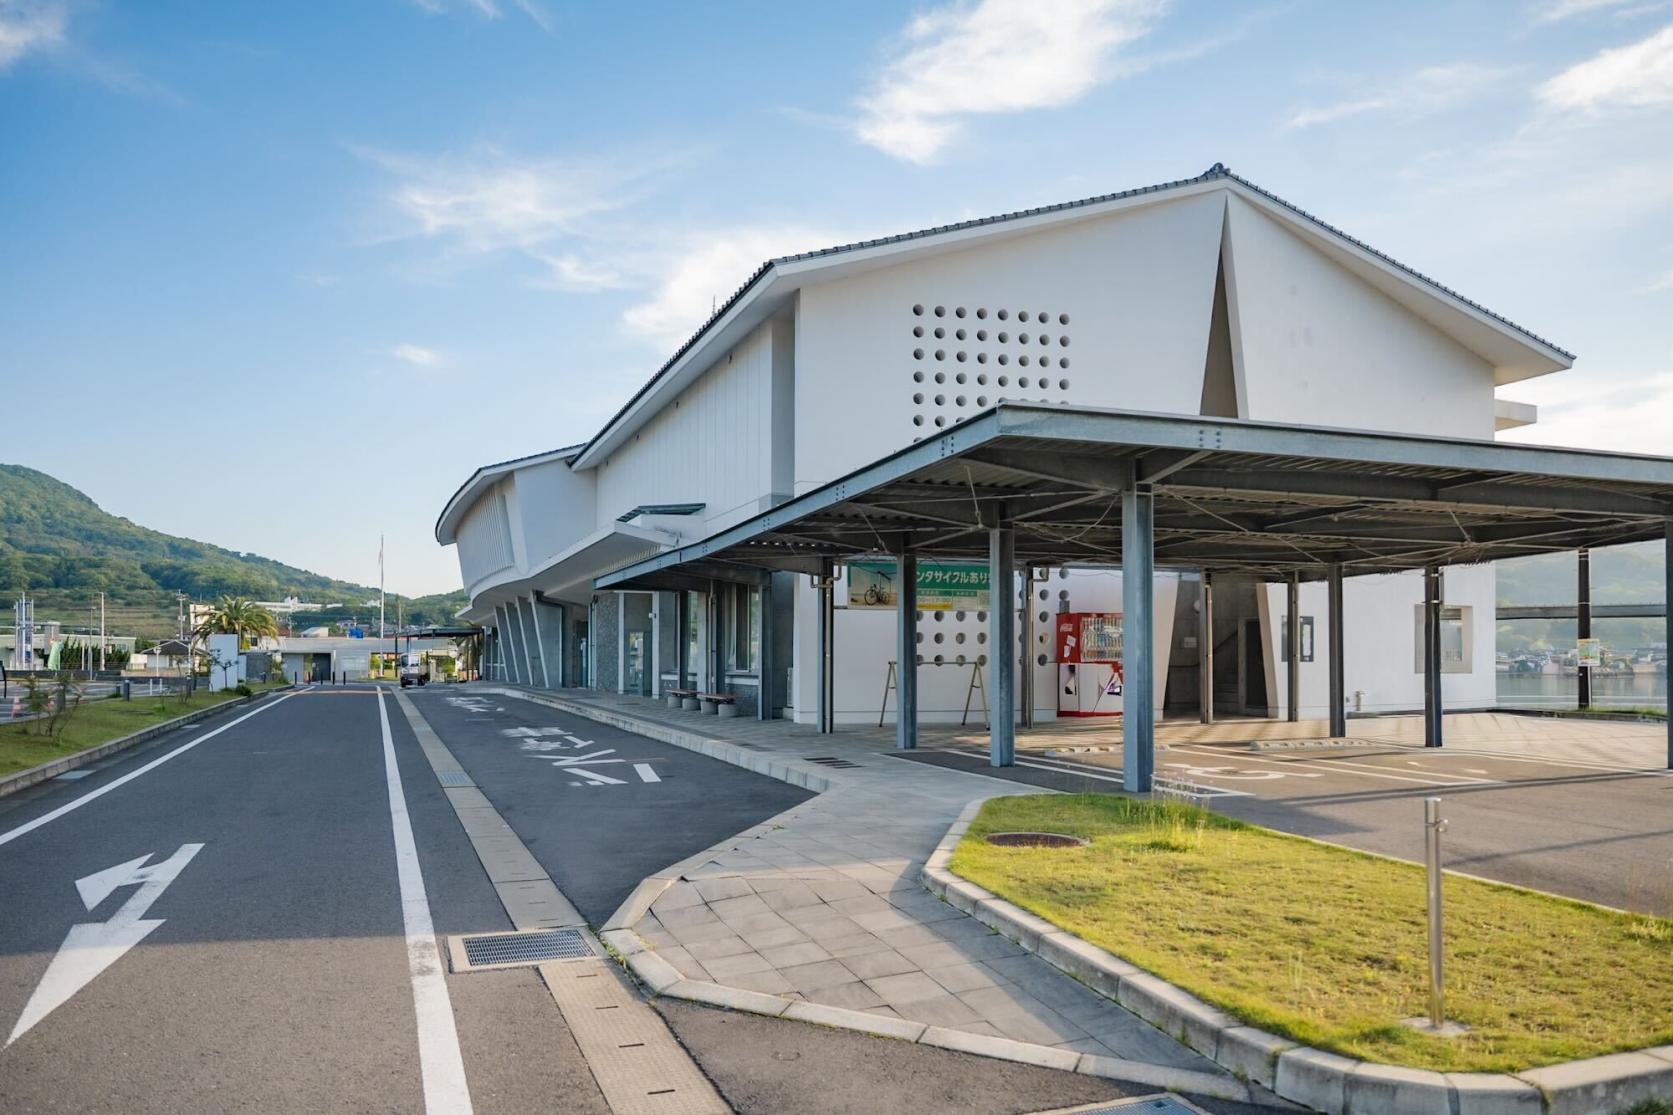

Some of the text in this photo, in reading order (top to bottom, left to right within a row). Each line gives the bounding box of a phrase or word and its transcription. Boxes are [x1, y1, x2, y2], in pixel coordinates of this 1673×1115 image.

[916, 570, 991, 584] ンタサイクルあり
